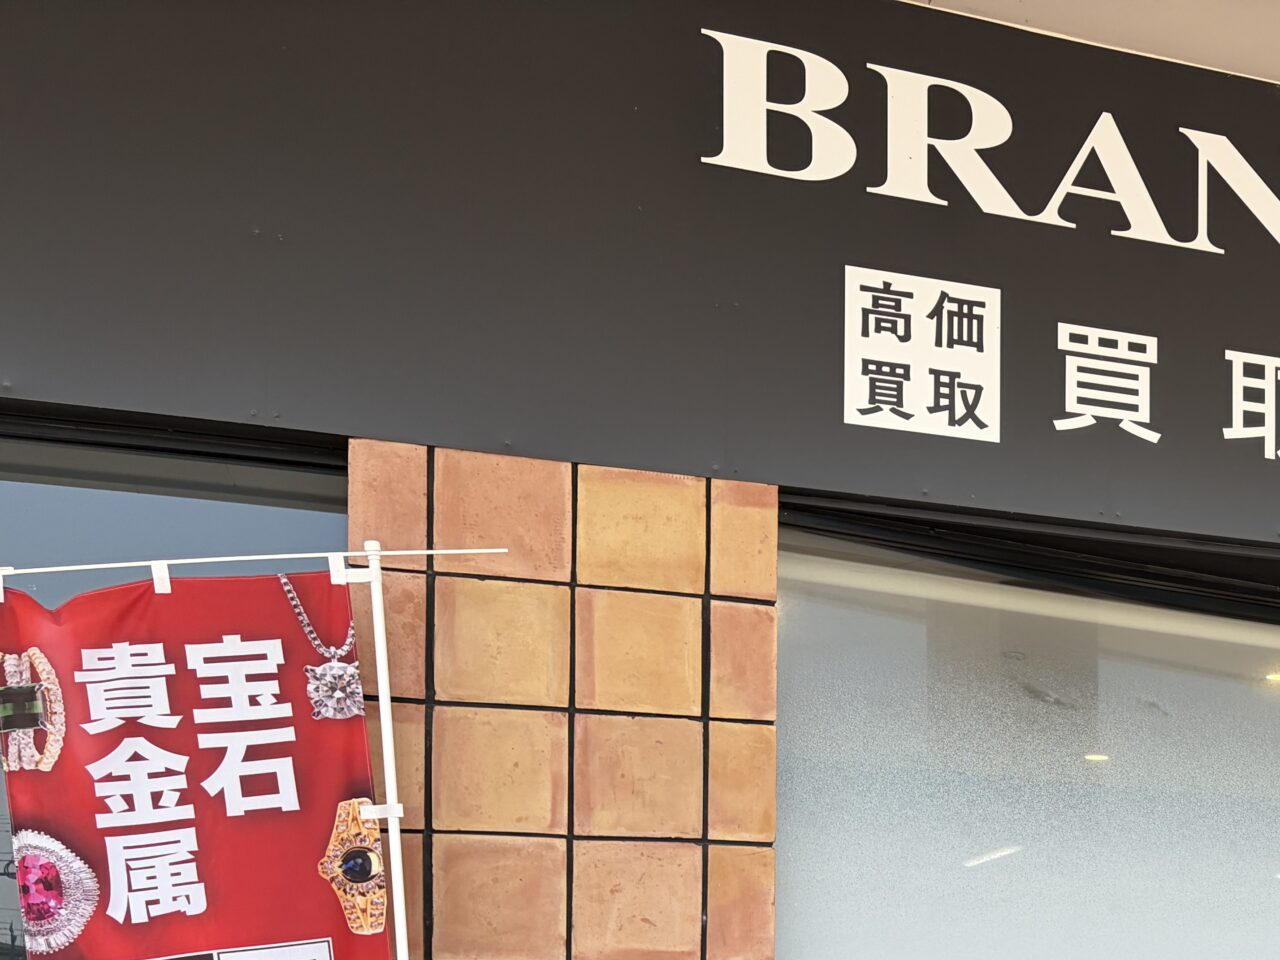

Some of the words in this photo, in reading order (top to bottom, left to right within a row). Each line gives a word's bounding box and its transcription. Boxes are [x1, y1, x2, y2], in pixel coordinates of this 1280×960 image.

[859, 280, 987, 353] 高価
[856, 357, 989, 430] 買取
[74, 641, 208, 925] 貴金属
[184, 635, 300, 817] 宝石
